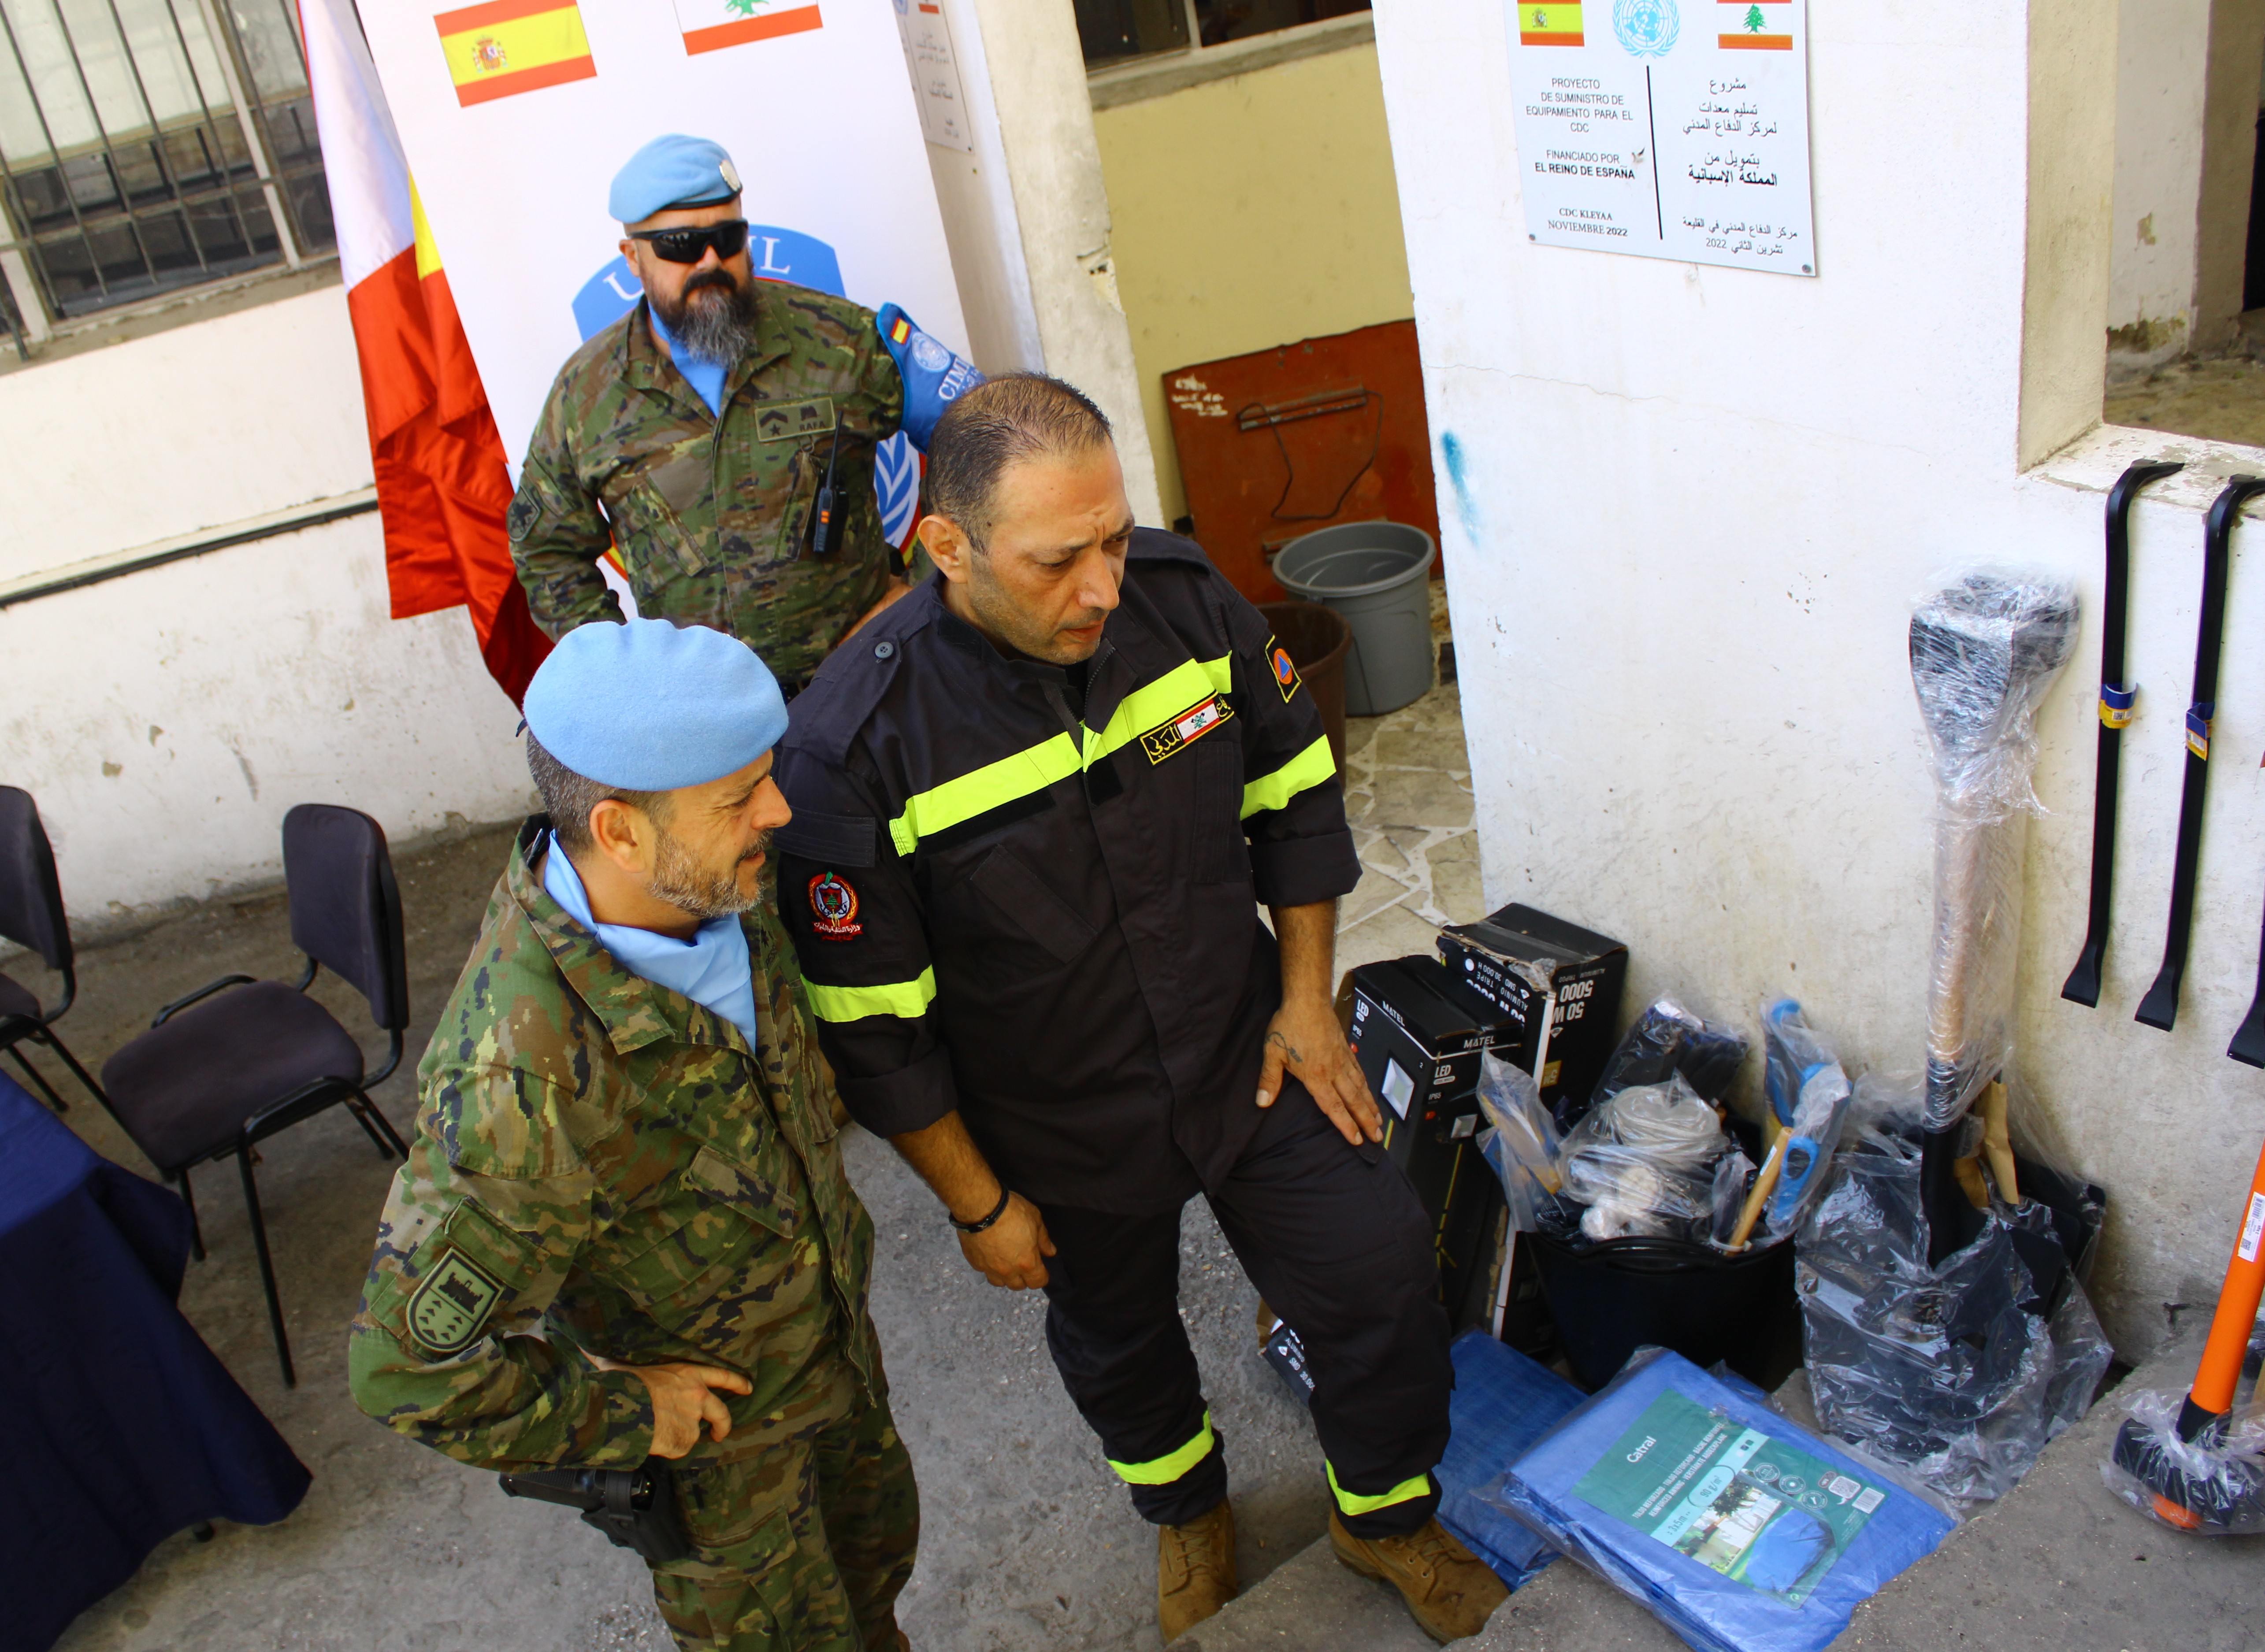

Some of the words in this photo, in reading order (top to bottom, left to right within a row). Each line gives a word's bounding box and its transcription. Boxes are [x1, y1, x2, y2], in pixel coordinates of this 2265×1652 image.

[1552, 78, 1600, 89] PROYECTO
[1709, 78, 1746, 95] مشروع
[1541, 92, 1553, 102] DE
[1555, 93, 1609, 105] SUMINISTRO
[1611, 95, 1624, 105] DE
[1526, 106, 1590, 118] EQUIPAMIENTO
[1594, 109, 1618, 120] PARA
[1622, 111, 1634, 121] EL
[1699, 101, 1730, 113] معدات
[1734, 102, 1758, 119] تسليم
[1570, 122, 1589, 133] CDC
[1682, 118, 1711, 135] المدني
[1715, 119, 1741, 137] الدفاع
[1747, 121, 1777, 137] لمركز
[1546, 150, 1598, 162] FINANCIADO
[1601, 153, 1620, 164] POR
[1704, 152, 1720, 165] من
[1724, 150, 1760, 169] بتمويل
[1535, 162, 1547, 173] EL
[1548, 163, 1578, 175] REINO
[1580, 166, 1593, 176] DE
[1596, 165, 1636, 180] ESPAÑA
[1739, 168, 1778, 187] المملكة
[1559, 208, 1578, 218] CDC
[1580, 210, 1613, 221] KLEYAA
[1548, 220, 1605, 234] NOVIEMBRE
[1606, 227, 1628, 237] 2022
[1708, 220, 1719, 233] في
[1722, 222, 1745, 235] المدني
[1749, 224, 1771, 238] الدفاع
[1776, 226, 1798, 239] مركز
[1706, 237, 1727, 249] 2022
[1731, 241, 1753, 255] الثاني
[1756, 244, 1783, 256] تشرين
[1505, 978, 1516, 991] SMD
[1560, 980, 1593, 1003] 5000
[1500, 987, 1529, 1011] ALUMINIO
[1357, 999, 1369, 1017] LED
[1383, 1000, 1405, 1027] MATEL
[1552, 1006, 1565, 1025] W
[1567, 1001, 1585, 1021] 50
[1463, 1036, 1495, 1048] MATEL
[1434, 1064, 1452, 1078] LED
[1288, 1357, 1300, 1371] SMD
[1627, 1435, 1657, 1463] Catral
[1632, 1506, 1648, 1519] TOLDO
[1643, 1486, 1666, 1509] REFORZADO
[1663, 1473, 1678, 1486] TOLDO
[1649, 1494, 1672, 1517] REINFORCED
[1668, 1480, 1686, 1496] AWNING
[1700, 1489, 1712, 1498] 90
[1668, 1515, 1688, 1532] 3x5m
